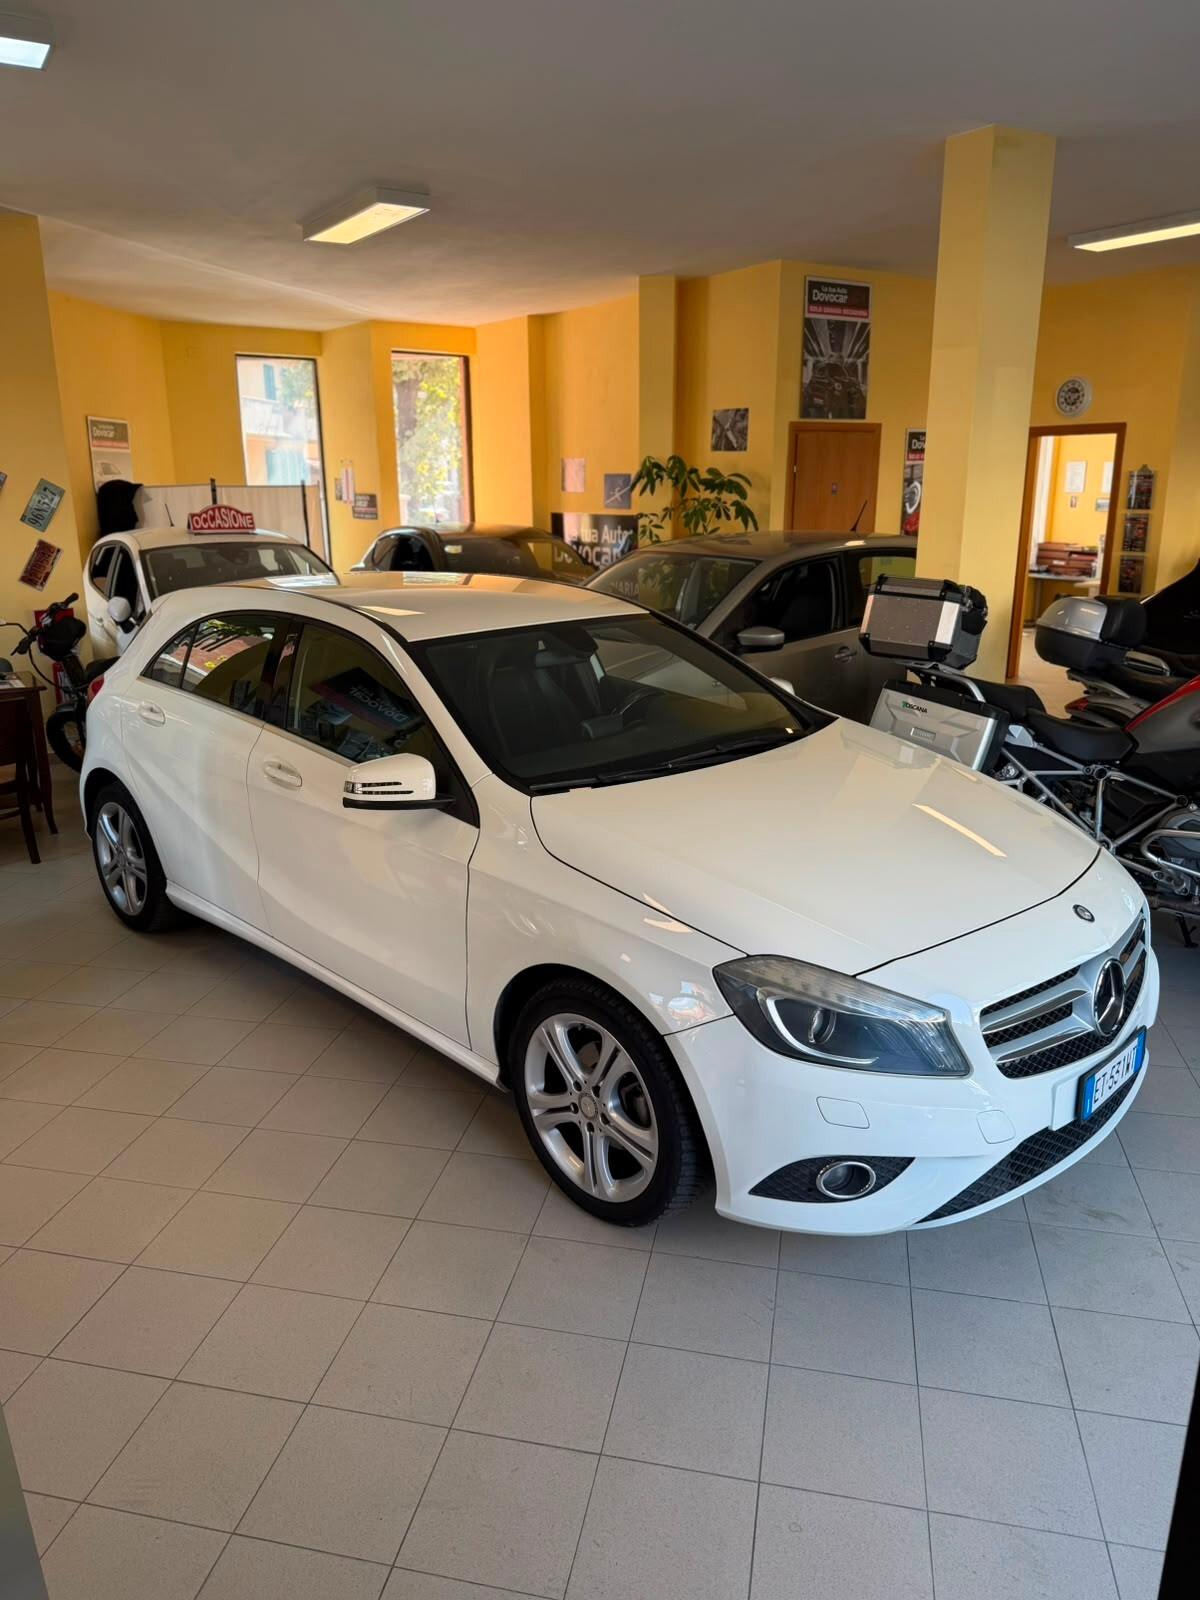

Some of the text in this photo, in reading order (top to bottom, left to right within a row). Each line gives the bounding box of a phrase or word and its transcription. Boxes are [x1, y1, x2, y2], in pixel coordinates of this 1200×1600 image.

[812, 289, 849, 304] Dovocar
[193, 507, 255, 529] OCCASIONE
[902, 700, 928, 713] TOSCANA
